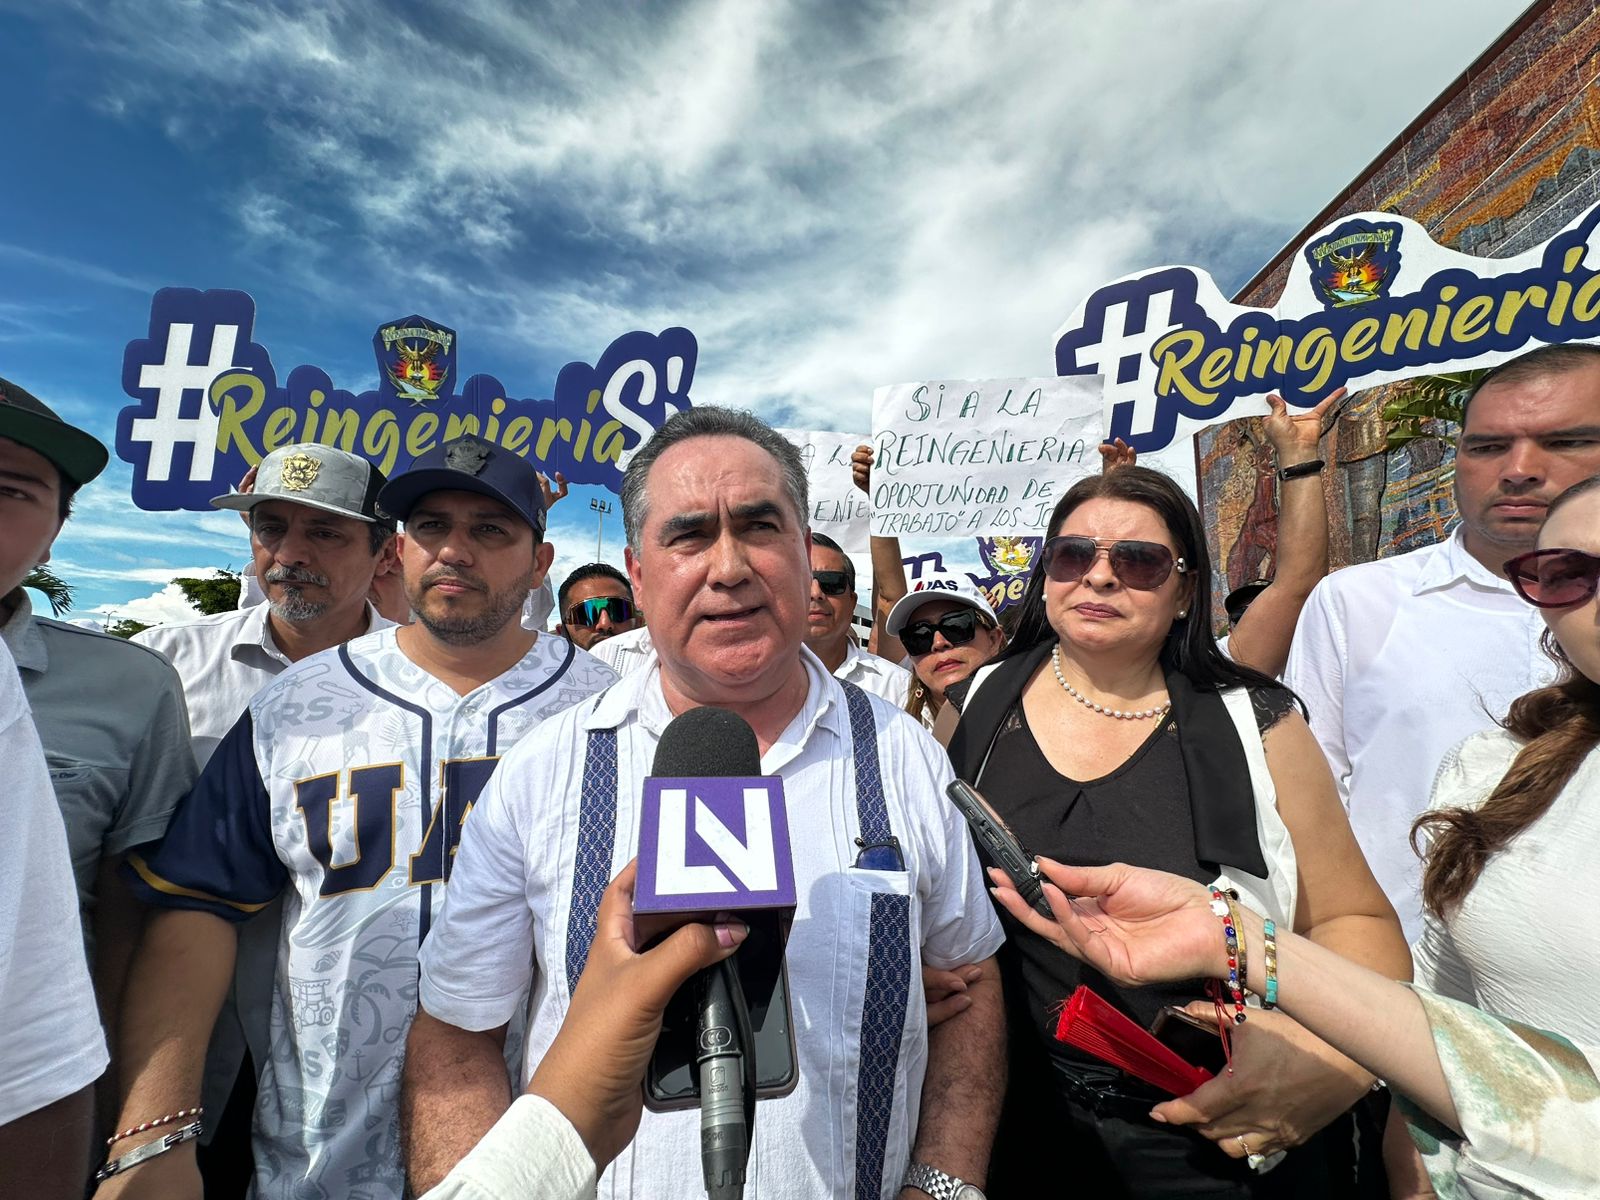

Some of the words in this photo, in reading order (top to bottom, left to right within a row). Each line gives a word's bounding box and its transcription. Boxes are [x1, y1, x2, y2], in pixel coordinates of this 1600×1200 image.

[959, 391, 980, 418] A
[997, 388, 1042, 417] LA
[828, 444, 853, 467] L
[1022, 478, 1055, 500] DE
[966, 509, 984, 529] A
[990, 507, 1022, 528] LOS
